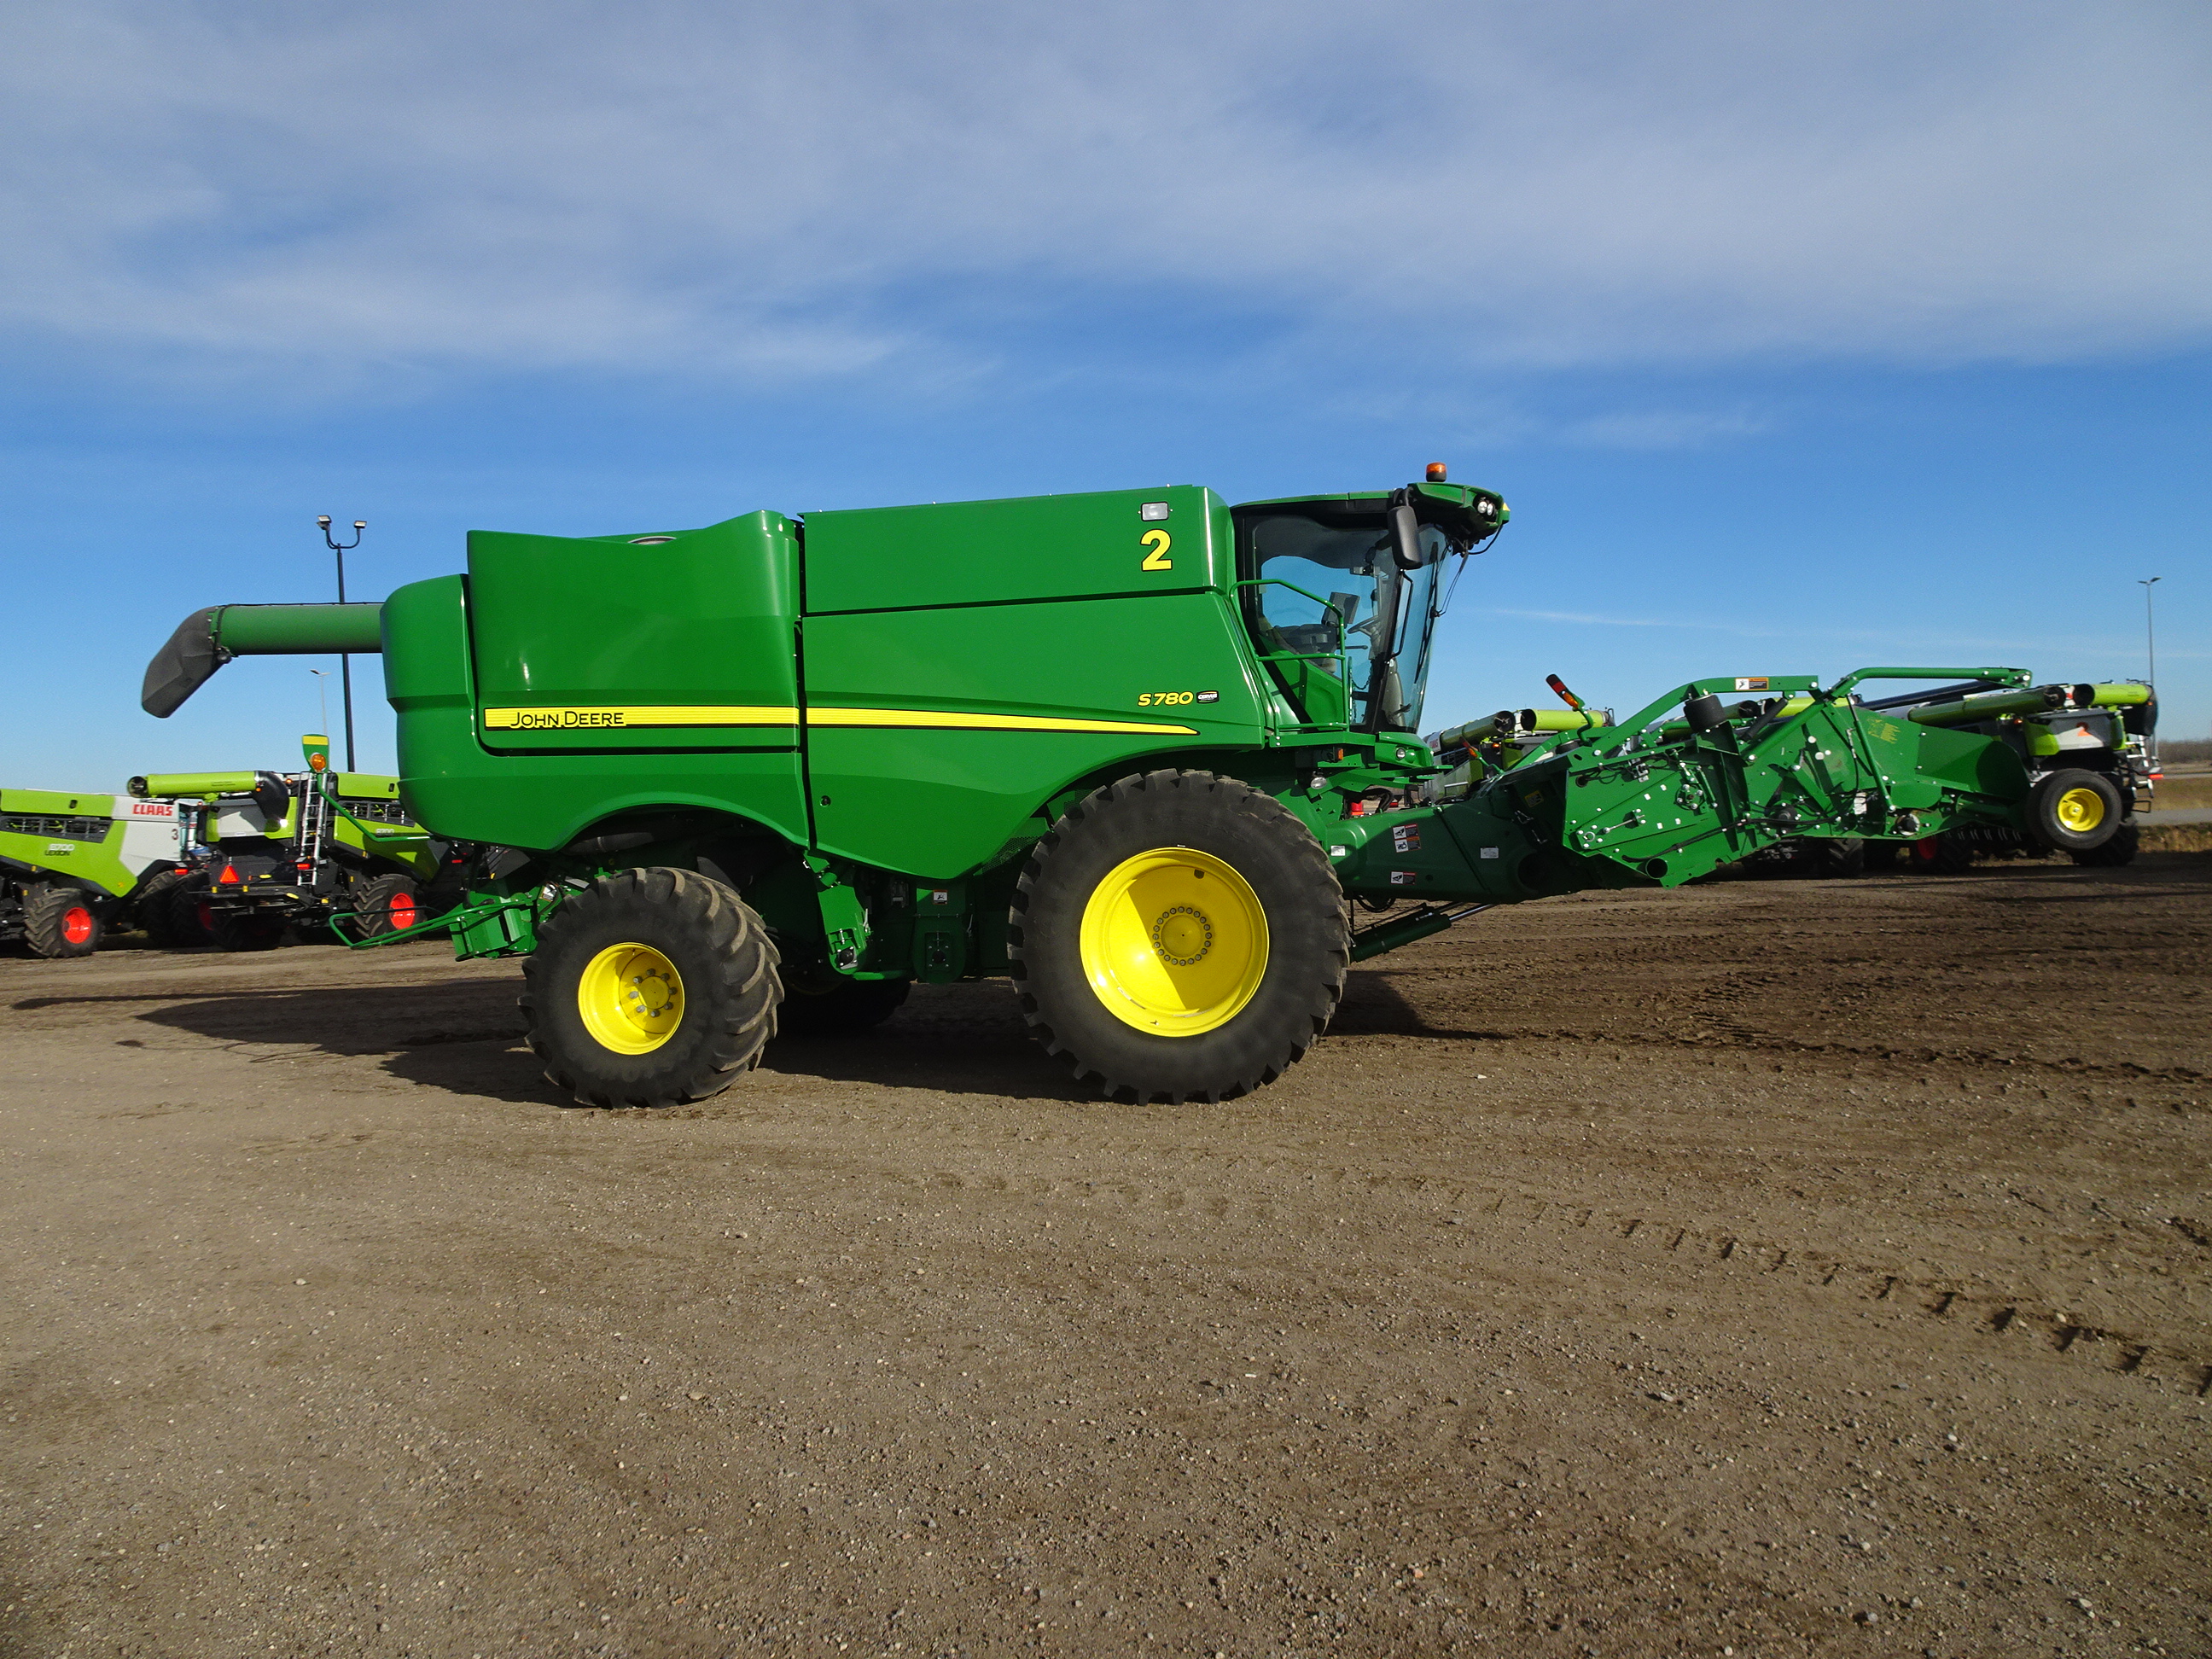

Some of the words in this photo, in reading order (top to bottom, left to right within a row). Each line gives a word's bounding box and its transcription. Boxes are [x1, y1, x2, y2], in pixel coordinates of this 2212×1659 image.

[1140, 528, 1173, 572] 2
[1138, 690, 1194, 707] S780
[510, 712, 559, 725] JOHN
[565, 711, 624, 725] DEERE
[132, 804, 173, 816] CLAAS
[172, 828, 178, 841] 3
